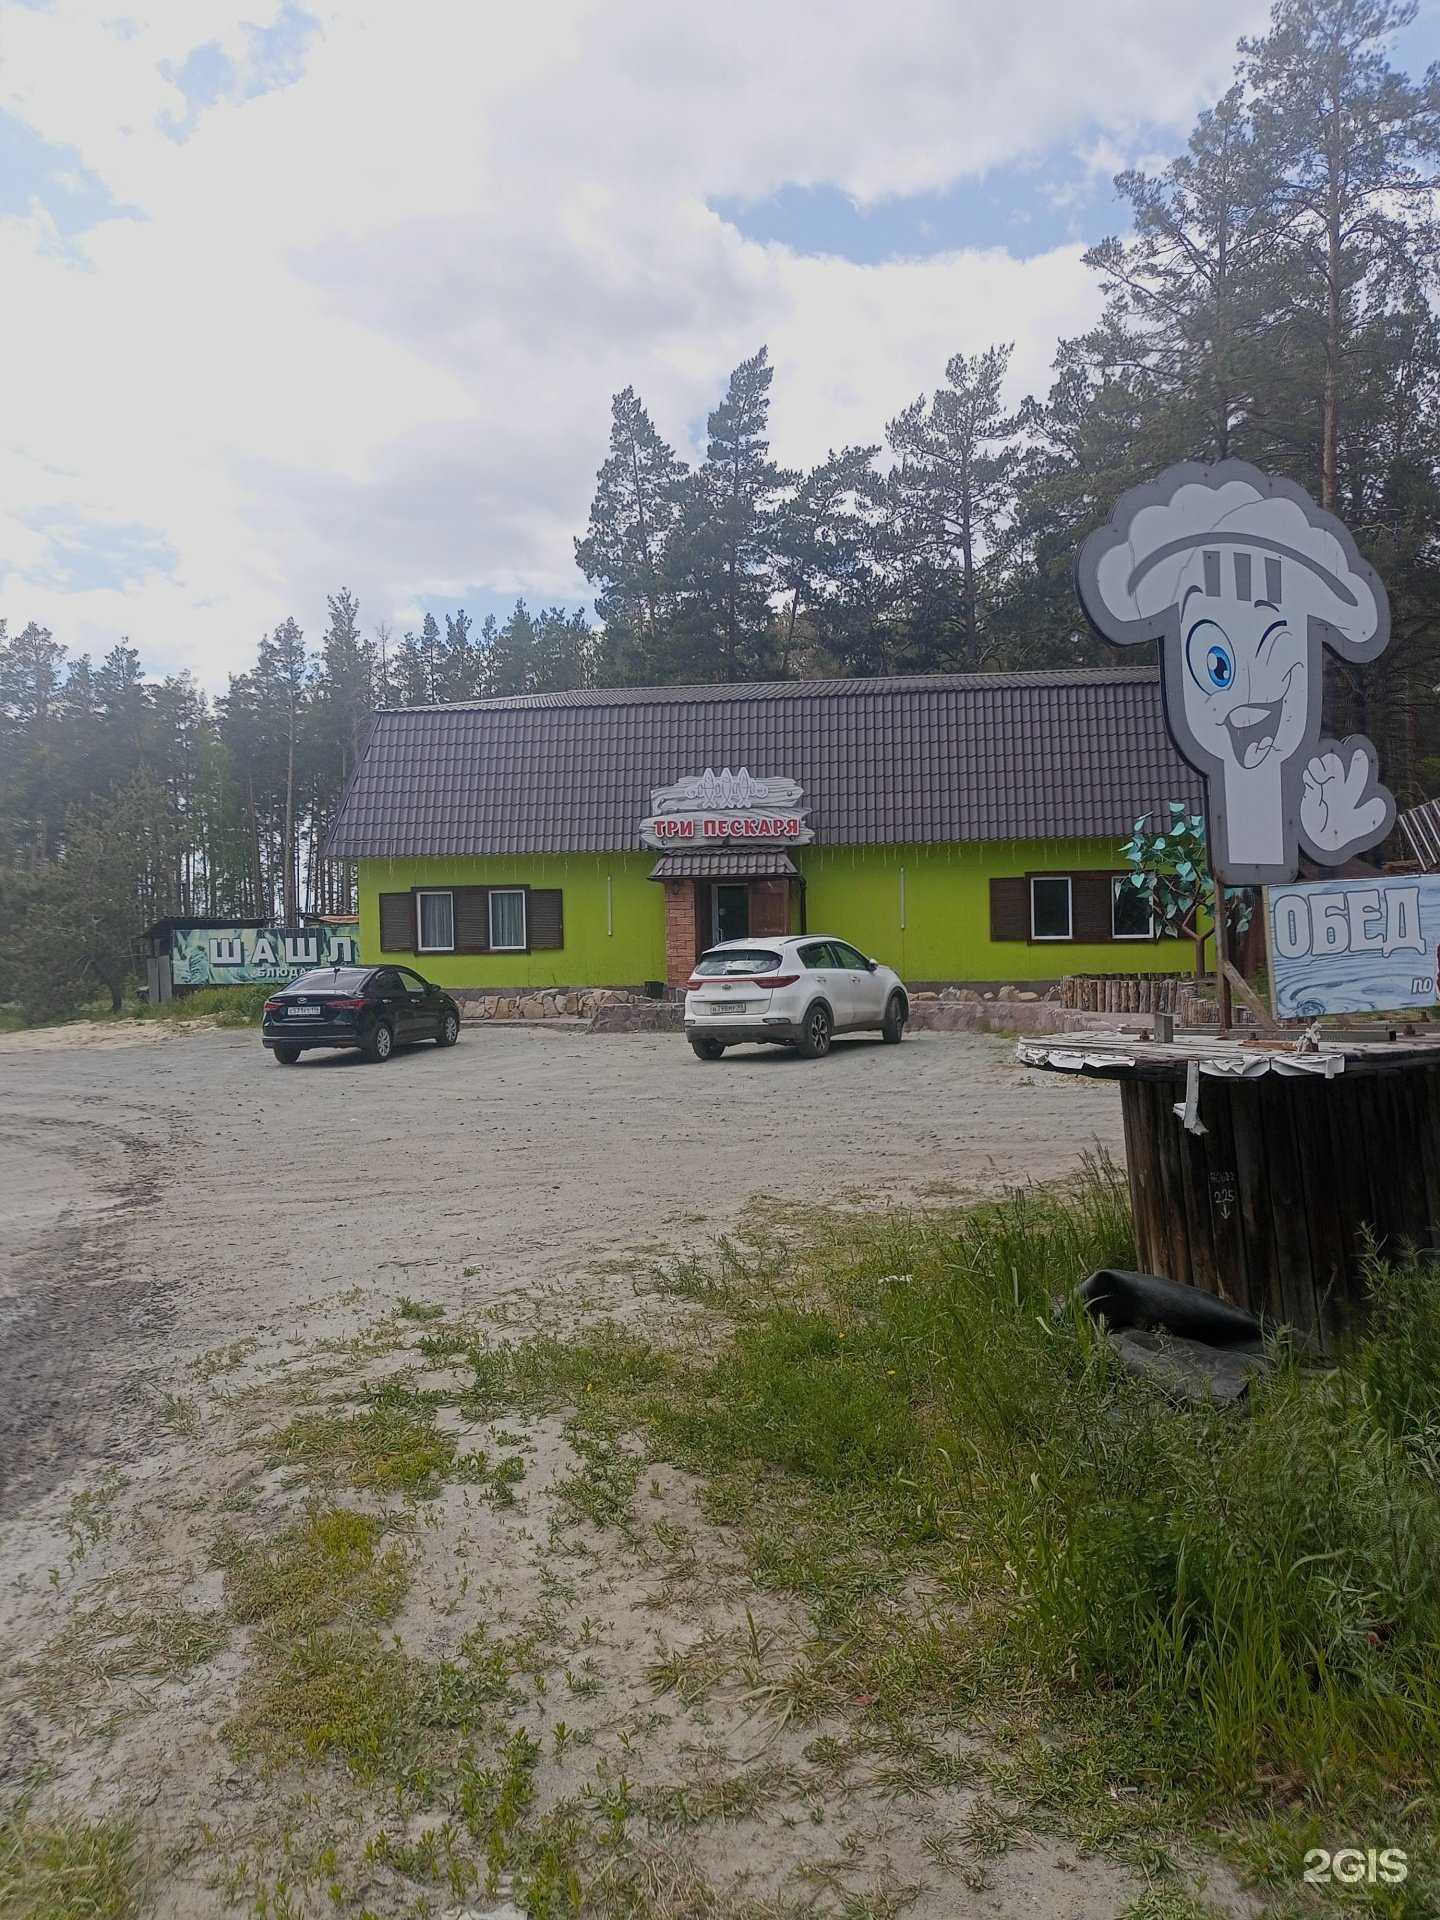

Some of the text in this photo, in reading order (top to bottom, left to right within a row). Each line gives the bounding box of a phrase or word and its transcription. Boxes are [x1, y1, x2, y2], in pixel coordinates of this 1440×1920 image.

[655, 818, 800, 838] ТРИ ПЕСКАРЯ
[1274, 887, 1426, 959] ОБЕД
